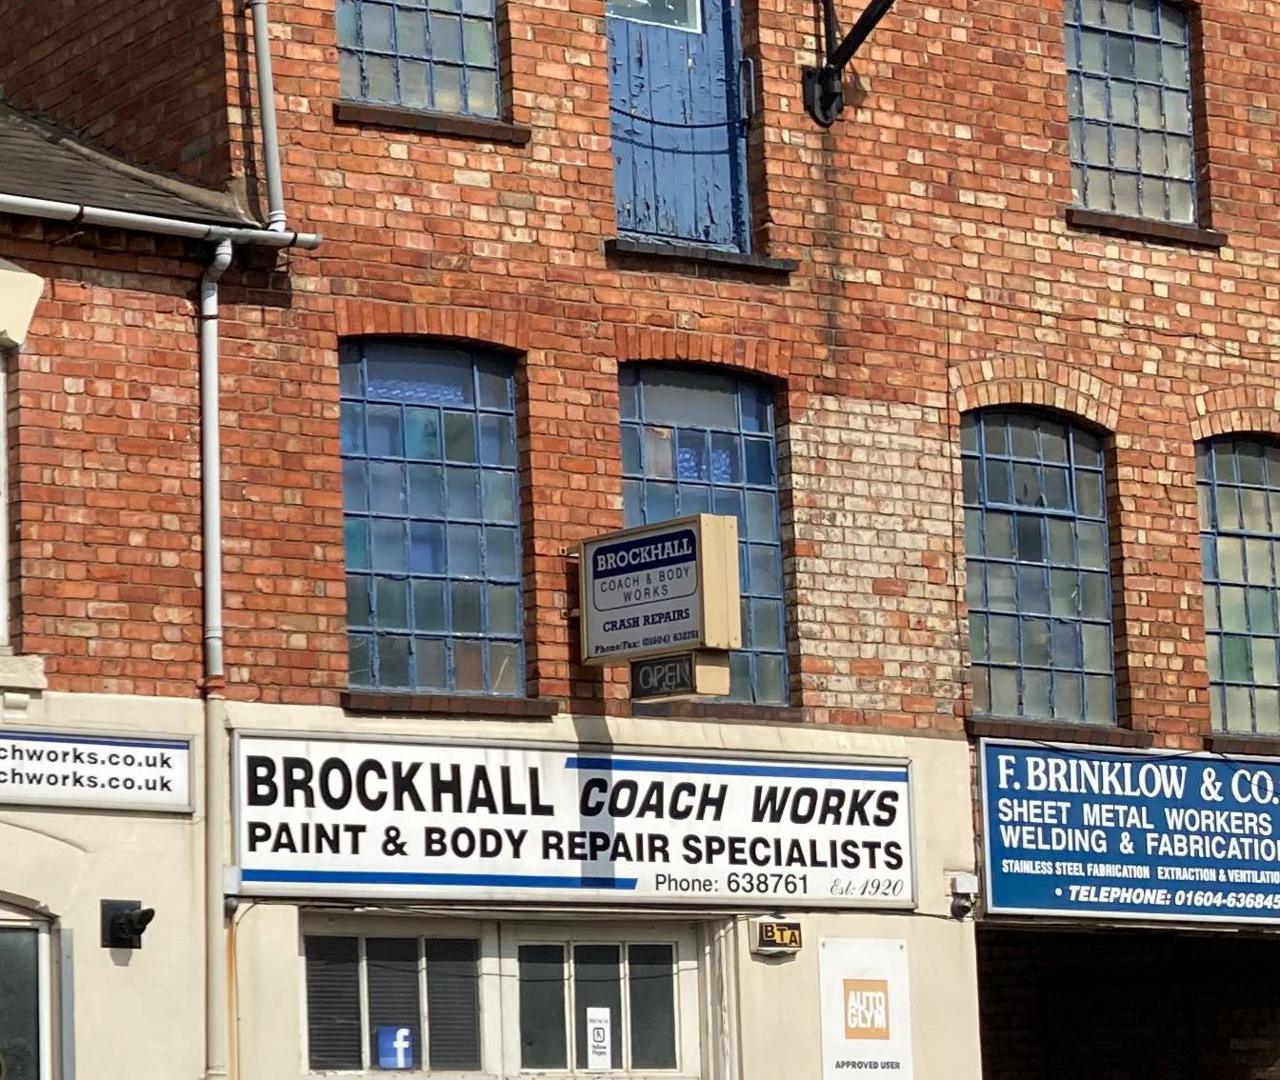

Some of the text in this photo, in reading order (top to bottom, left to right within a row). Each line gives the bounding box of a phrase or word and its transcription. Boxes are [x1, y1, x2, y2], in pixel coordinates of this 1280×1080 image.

[596, 537, 693, 572] BROCKHALL
[600, 566, 690, 593] COACH & BODY
[623, 584, 669, 602] WORKS
[602, 608, 690, 633] CRASH REPAIRS
[246, 755, 900, 827] BROCKHALL COACH WORKS
[997, 754, 1280, 805] F. BRINKLOW & CO.
[998, 797, 1273, 836] SHEET METAL WORKERS
[247, 821, 904, 870] PAINT & BODY REPAIR SPECIALISTS
[999, 824, 1280, 862] WELDING & FABRICATIO
[1001, 858, 1054, 875] STAINLESS
[1055, 861, 1085, 876] STEEL
[1087, 863, 1150, 878] FABRICATION
[1157, 866, 1216, 882] EXTRACTION
[1218, 869, 1228, 882] &
[655, 873, 719, 892] Phone:
[727, 873, 809, 894] 638761
[1069, 885, 1280, 910] TELEPHONE: 01604-636845
[764, 924, 798, 946] BTA
[848, 991, 886, 1009] AUTO
[847, 1008, 887, 1029] GLYM
[835, 1059, 901, 1070] APPROVED USER
